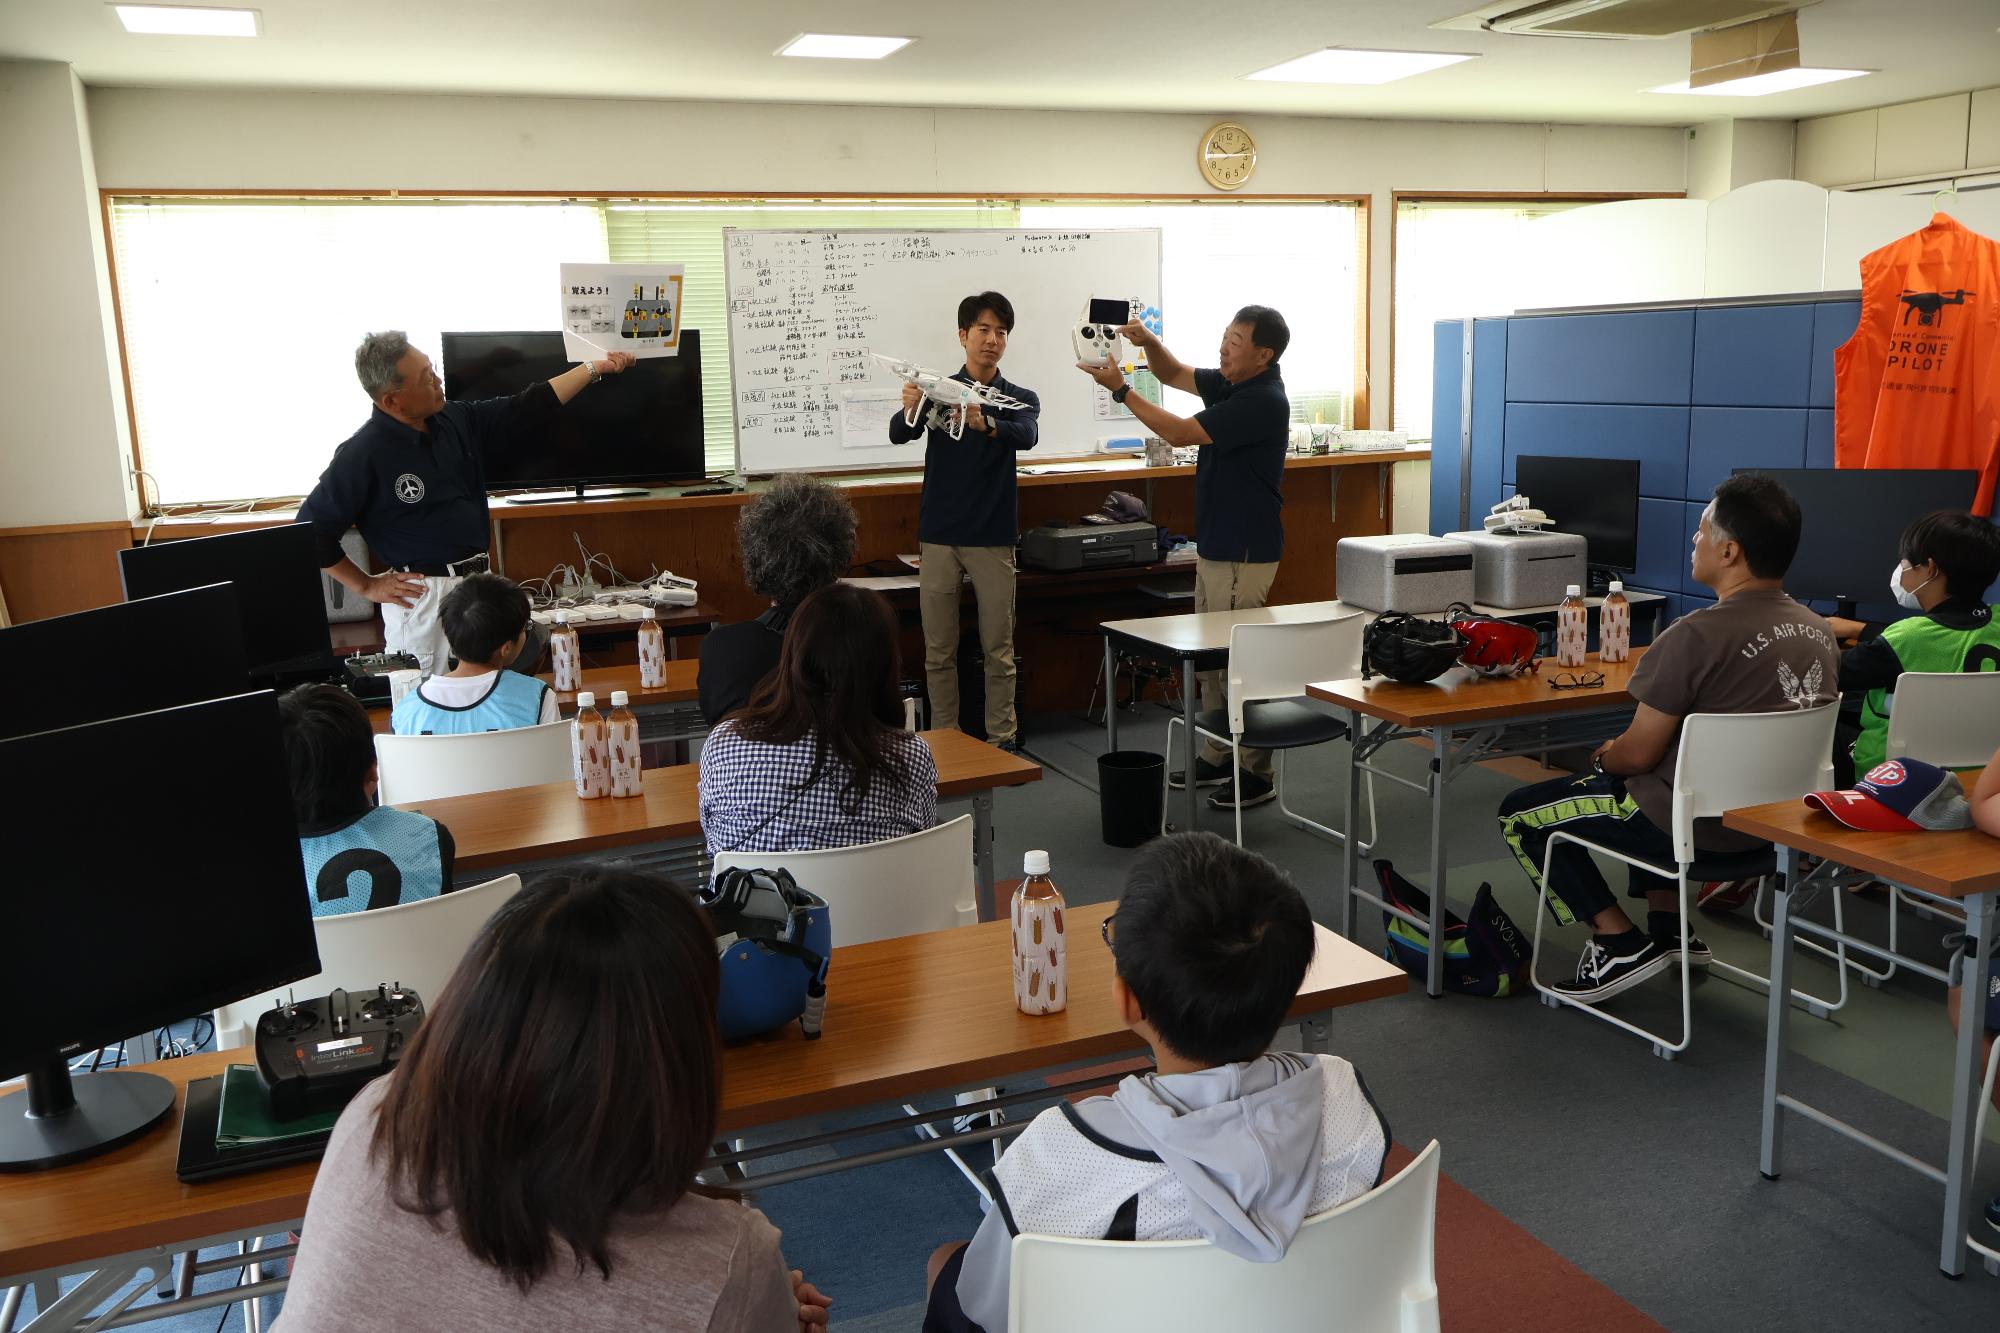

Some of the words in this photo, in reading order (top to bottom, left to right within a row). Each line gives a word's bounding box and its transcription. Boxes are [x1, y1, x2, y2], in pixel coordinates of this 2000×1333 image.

[1226, 132, 1233, 141] 12
[1225, 171, 1231, 180] 6
[1888, 355, 1943, 371] PILOT
[1742, 633, 1773, 659] U.S.
[1773, 623, 1797, 640] AIR
[1867, 762, 1900, 781] STP
